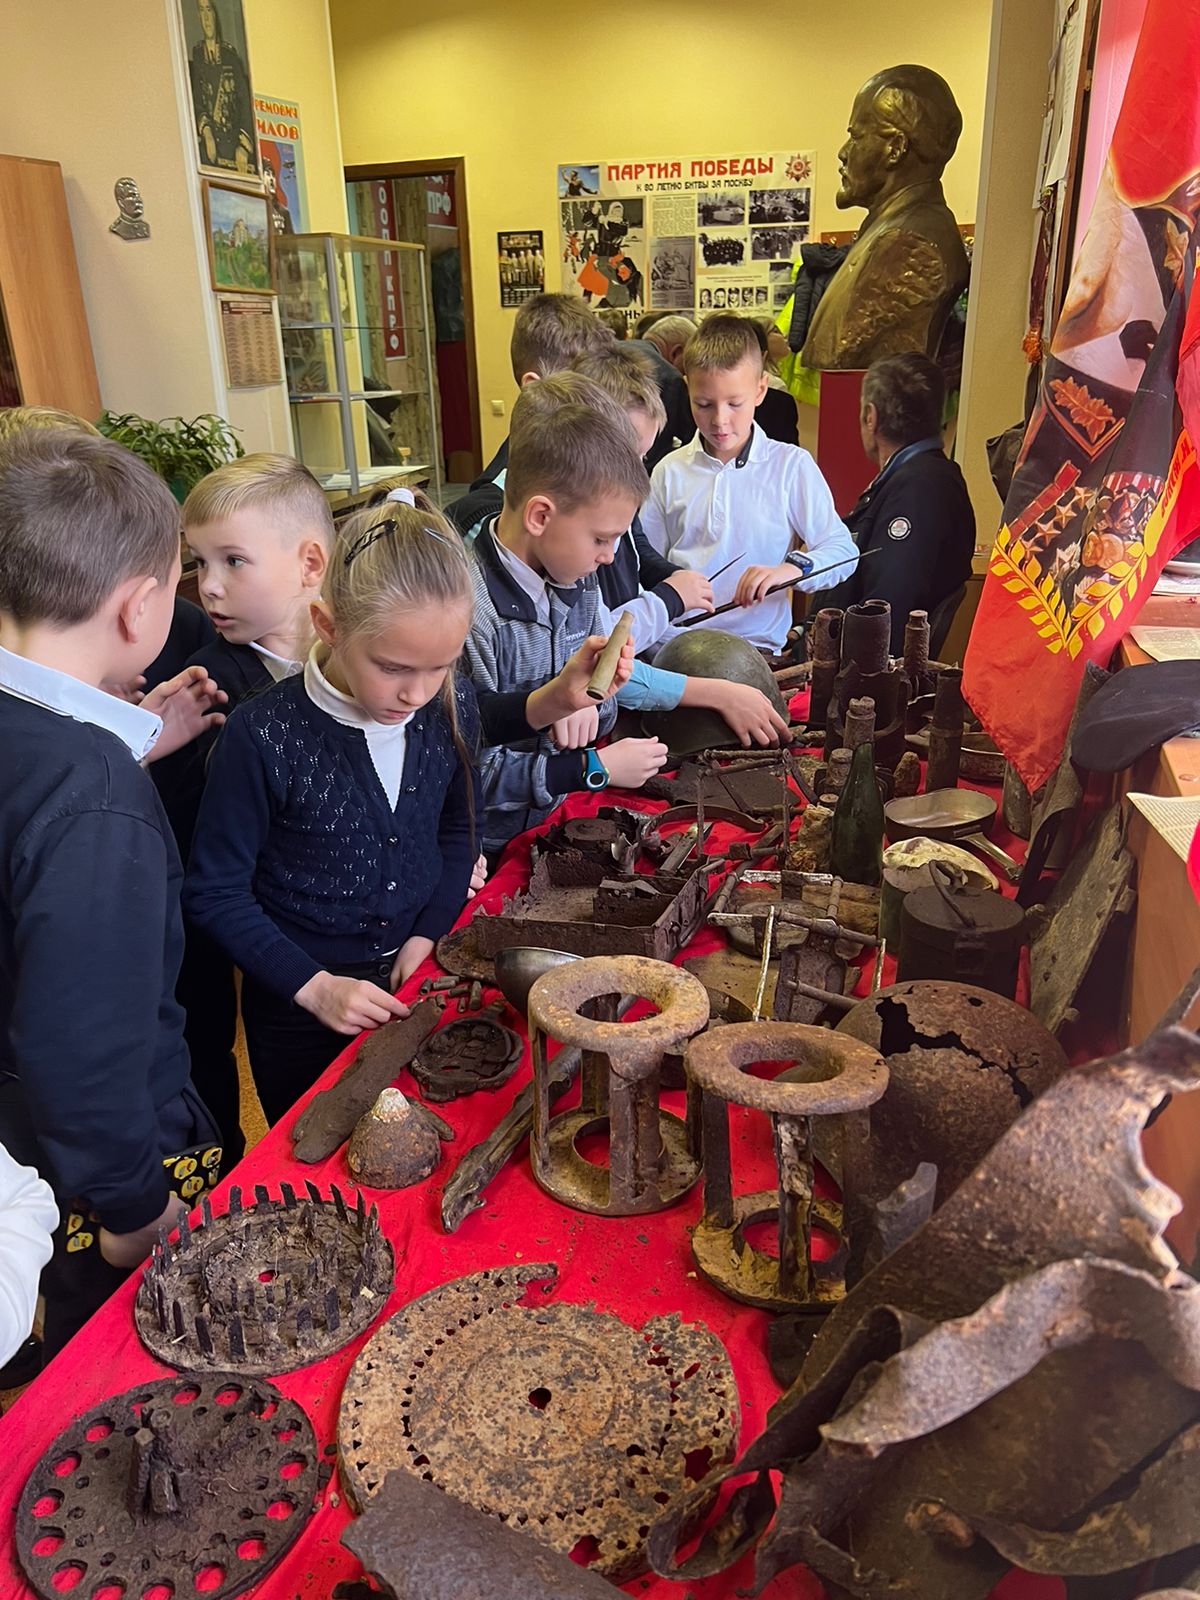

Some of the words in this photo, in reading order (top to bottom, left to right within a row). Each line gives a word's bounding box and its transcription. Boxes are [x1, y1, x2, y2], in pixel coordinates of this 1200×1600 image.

[608, 162, 682, 181] ПАРТИЯ
[691, 157, 774, 177] ПОБЕДЫ
[636, 184, 642, 192] К
[684, 179, 709, 190] БИТВЫ
[711, 179, 722, 188] ЗА
[723, 178, 754, 188] МОСКВУ
